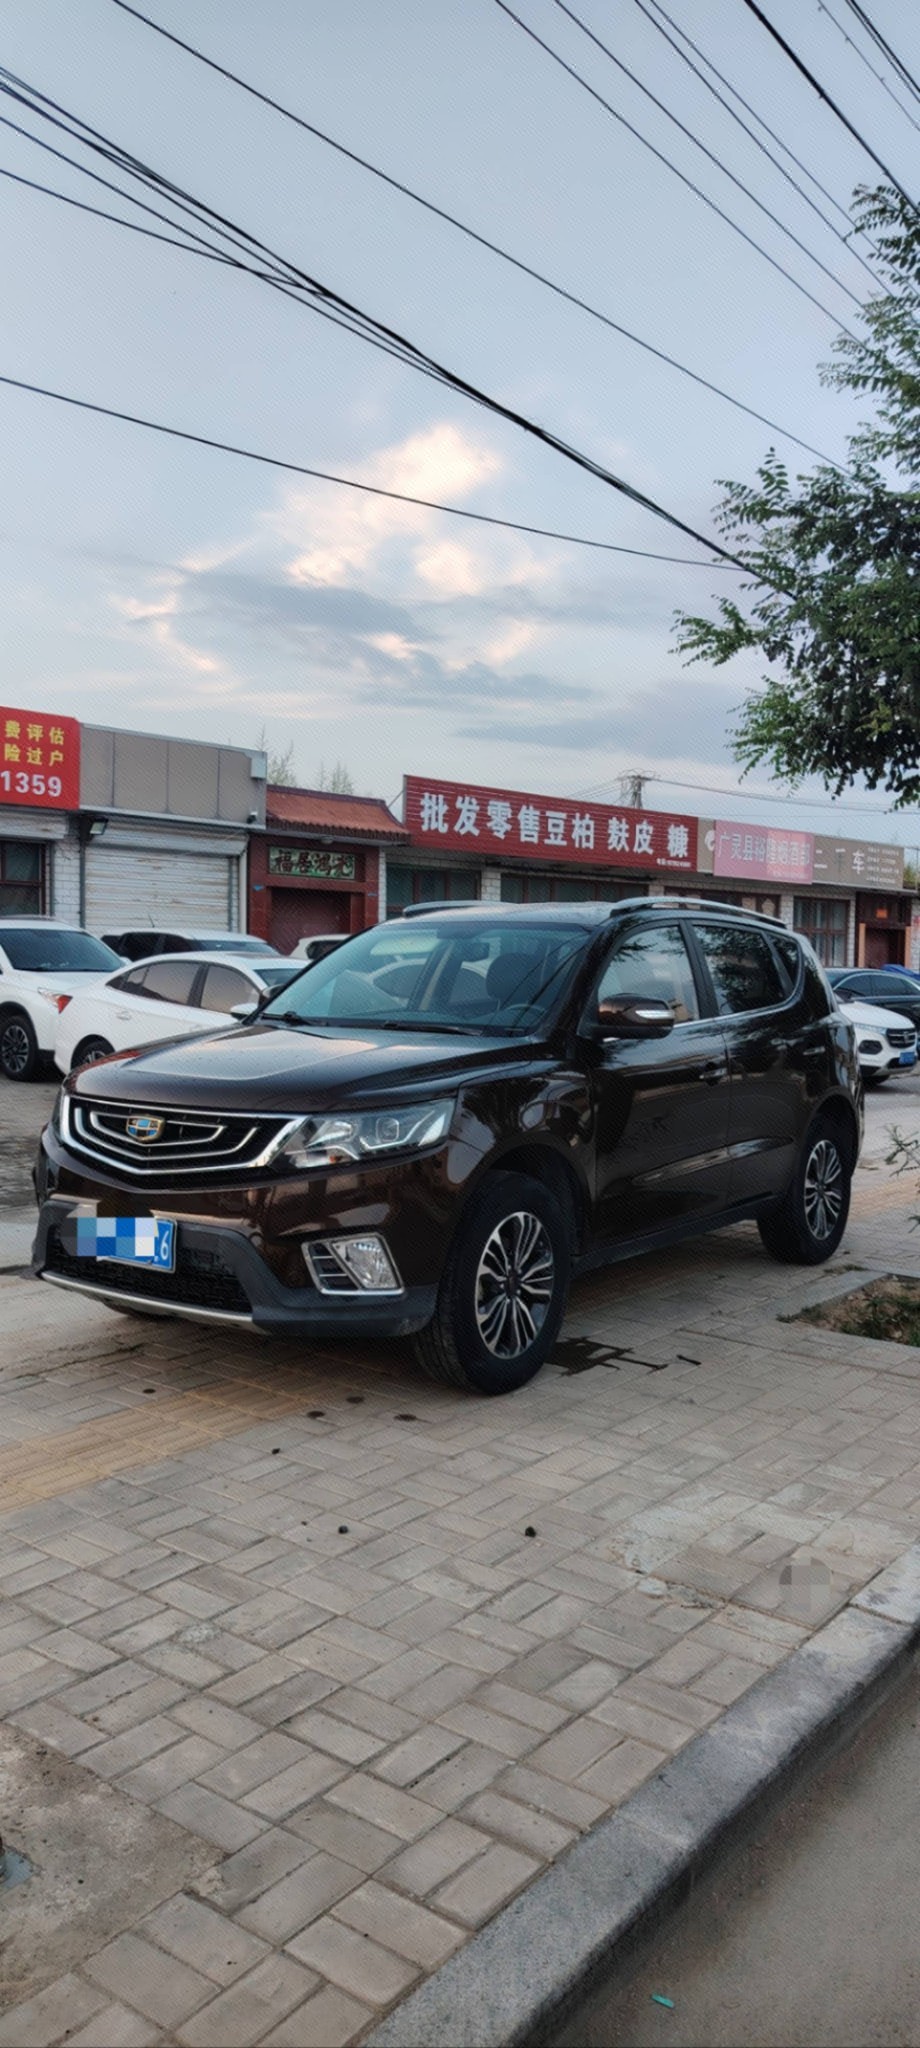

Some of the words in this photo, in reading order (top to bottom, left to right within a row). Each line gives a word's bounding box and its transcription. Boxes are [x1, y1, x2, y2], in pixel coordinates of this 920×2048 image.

[5, 720, 65, 746] 费评估
[4, 743, 64, 767] 险过户
[0, 770, 62, 797] 1359
[667, 823, 689, 858] 糠
